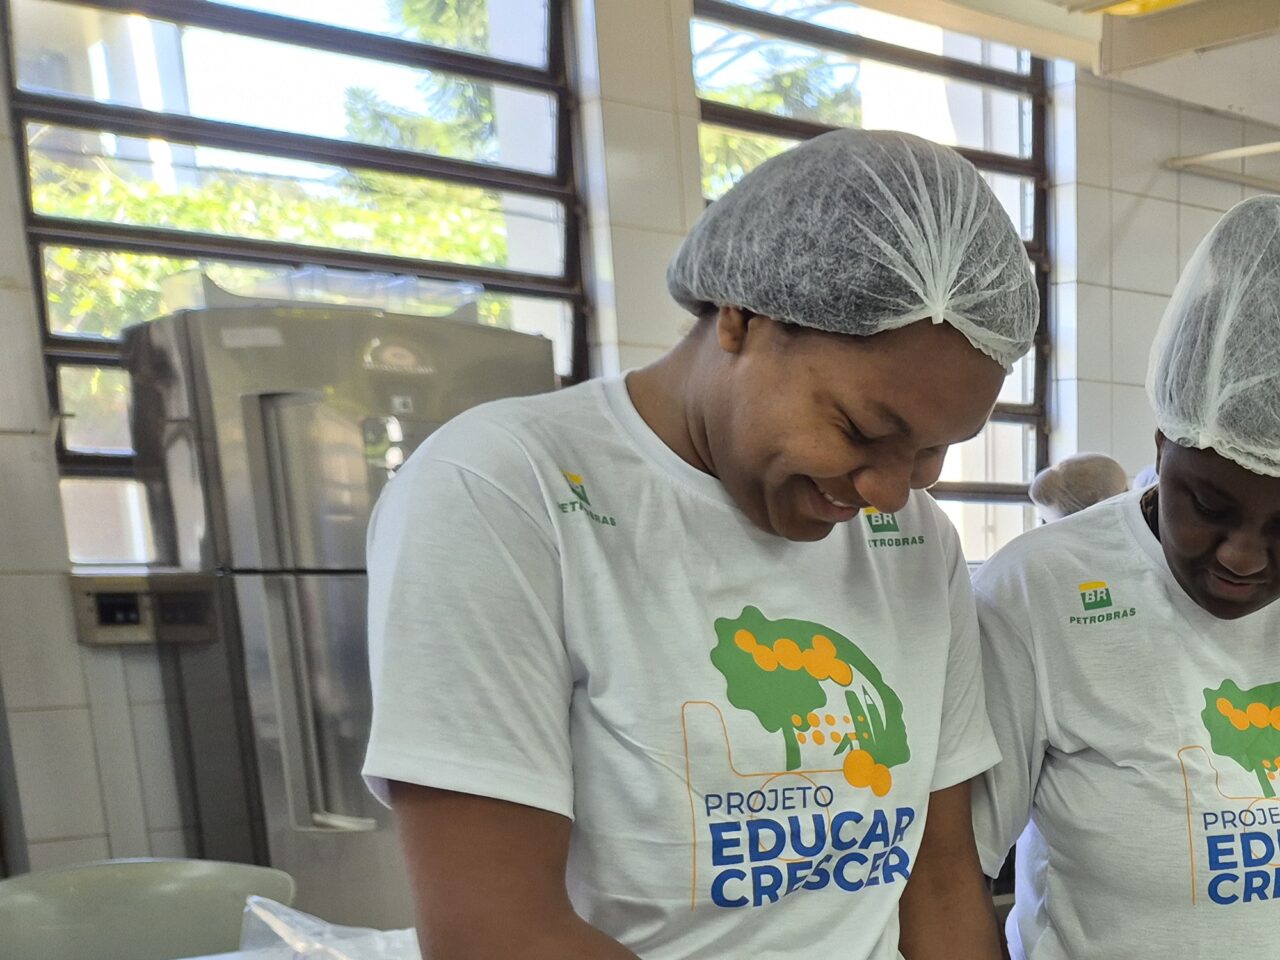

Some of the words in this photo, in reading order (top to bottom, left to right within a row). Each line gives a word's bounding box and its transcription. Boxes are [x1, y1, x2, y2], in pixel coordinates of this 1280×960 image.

[871, 513, 894, 525] BR
[868, 536, 925, 548] TROBRAS
[1085, 589, 1107, 603] BR
[1069, 608, 1137, 625] PETROBRAS
[705, 785, 834, 817] PROJETO
[709, 806, 916, 867] EDUCAR
[709, 845, 913, 909] CRESCER
